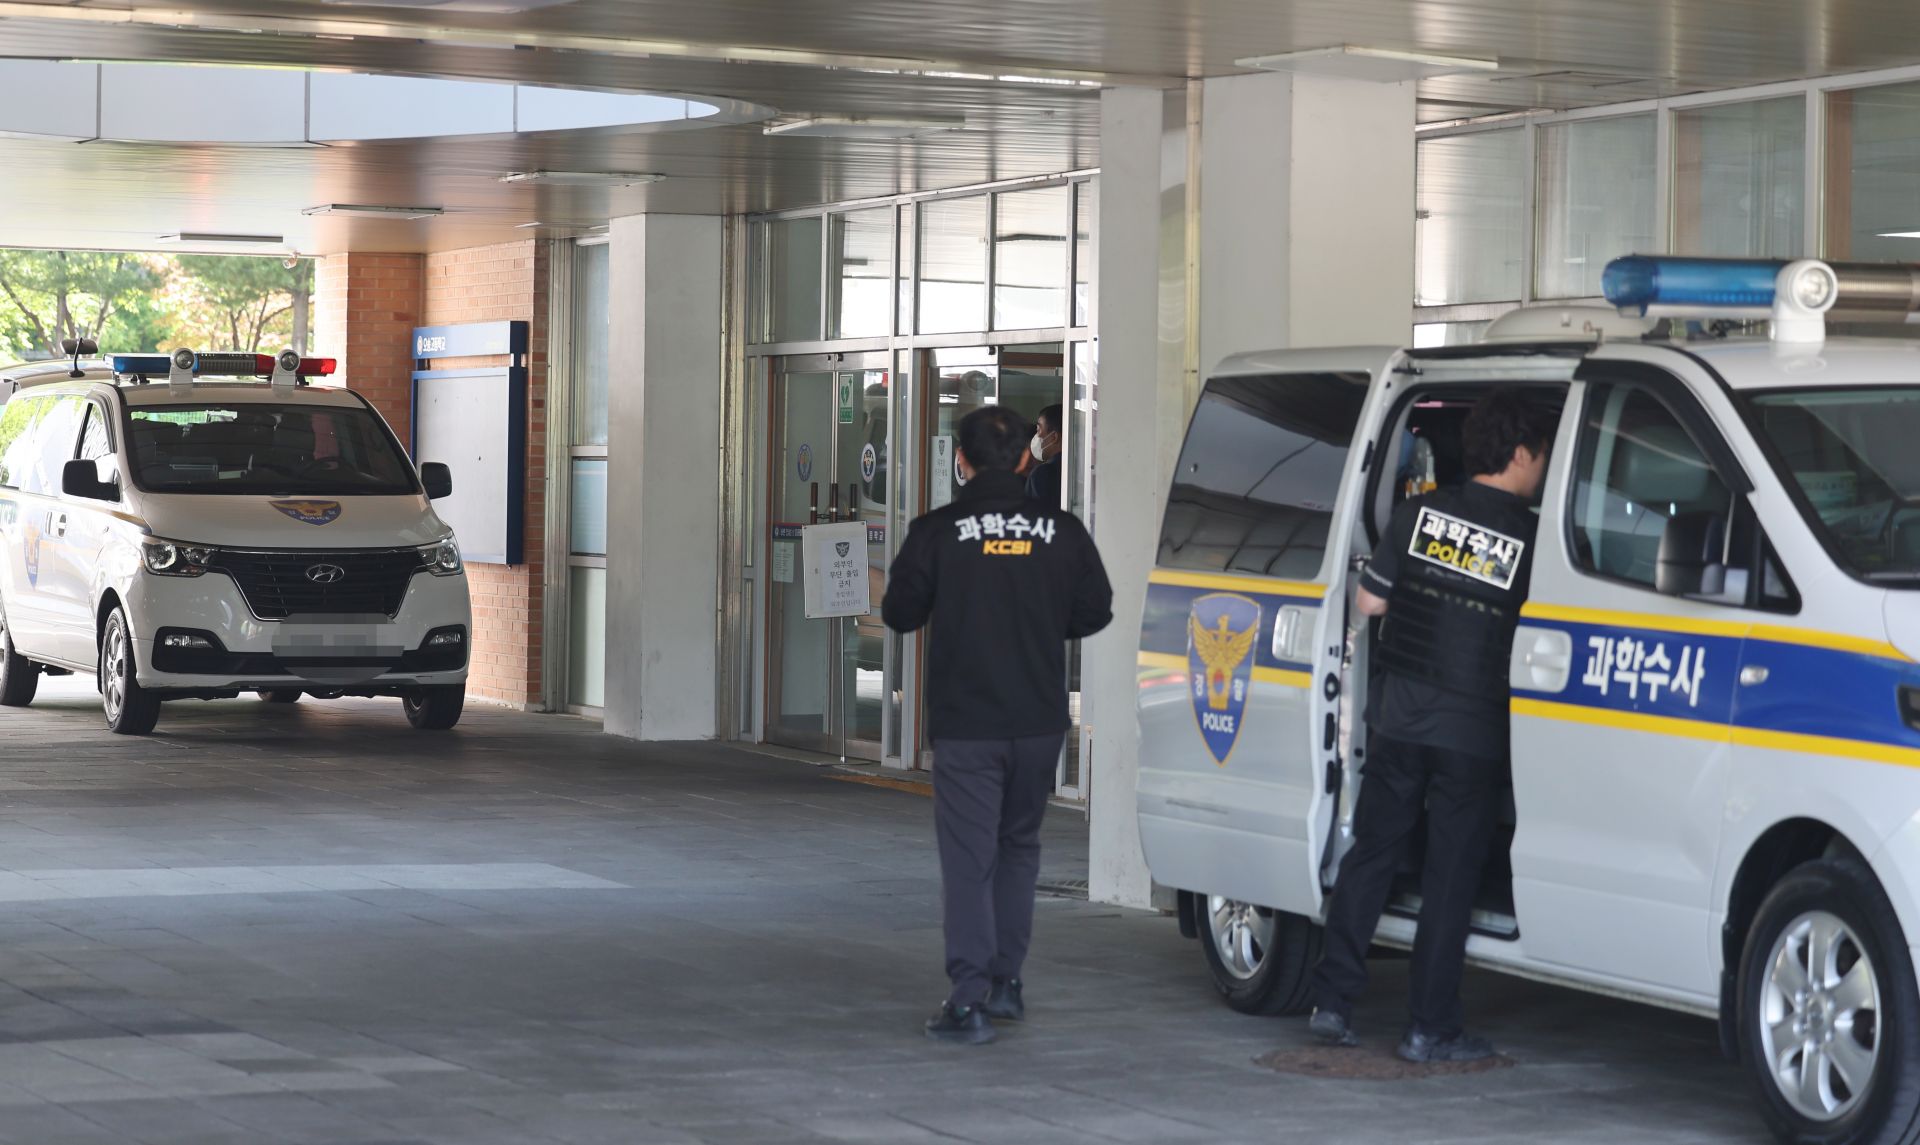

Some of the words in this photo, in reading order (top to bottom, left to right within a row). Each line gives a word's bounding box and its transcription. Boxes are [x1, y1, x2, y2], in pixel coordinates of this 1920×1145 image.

[955, 513, 1056, 544] 과학수사
[1422, 513, 1514, 565] 과학수사
[983, 540, 1032, 555] KCSI
[1426, 540, 1497, 578] POLICE
[833, 559, 853, 568] 외부인
[838, 579, 851, 588] 금지
[1582, 635, 1706, 708] 과학수사
[1202, 712, 1235, 734] POLICE
